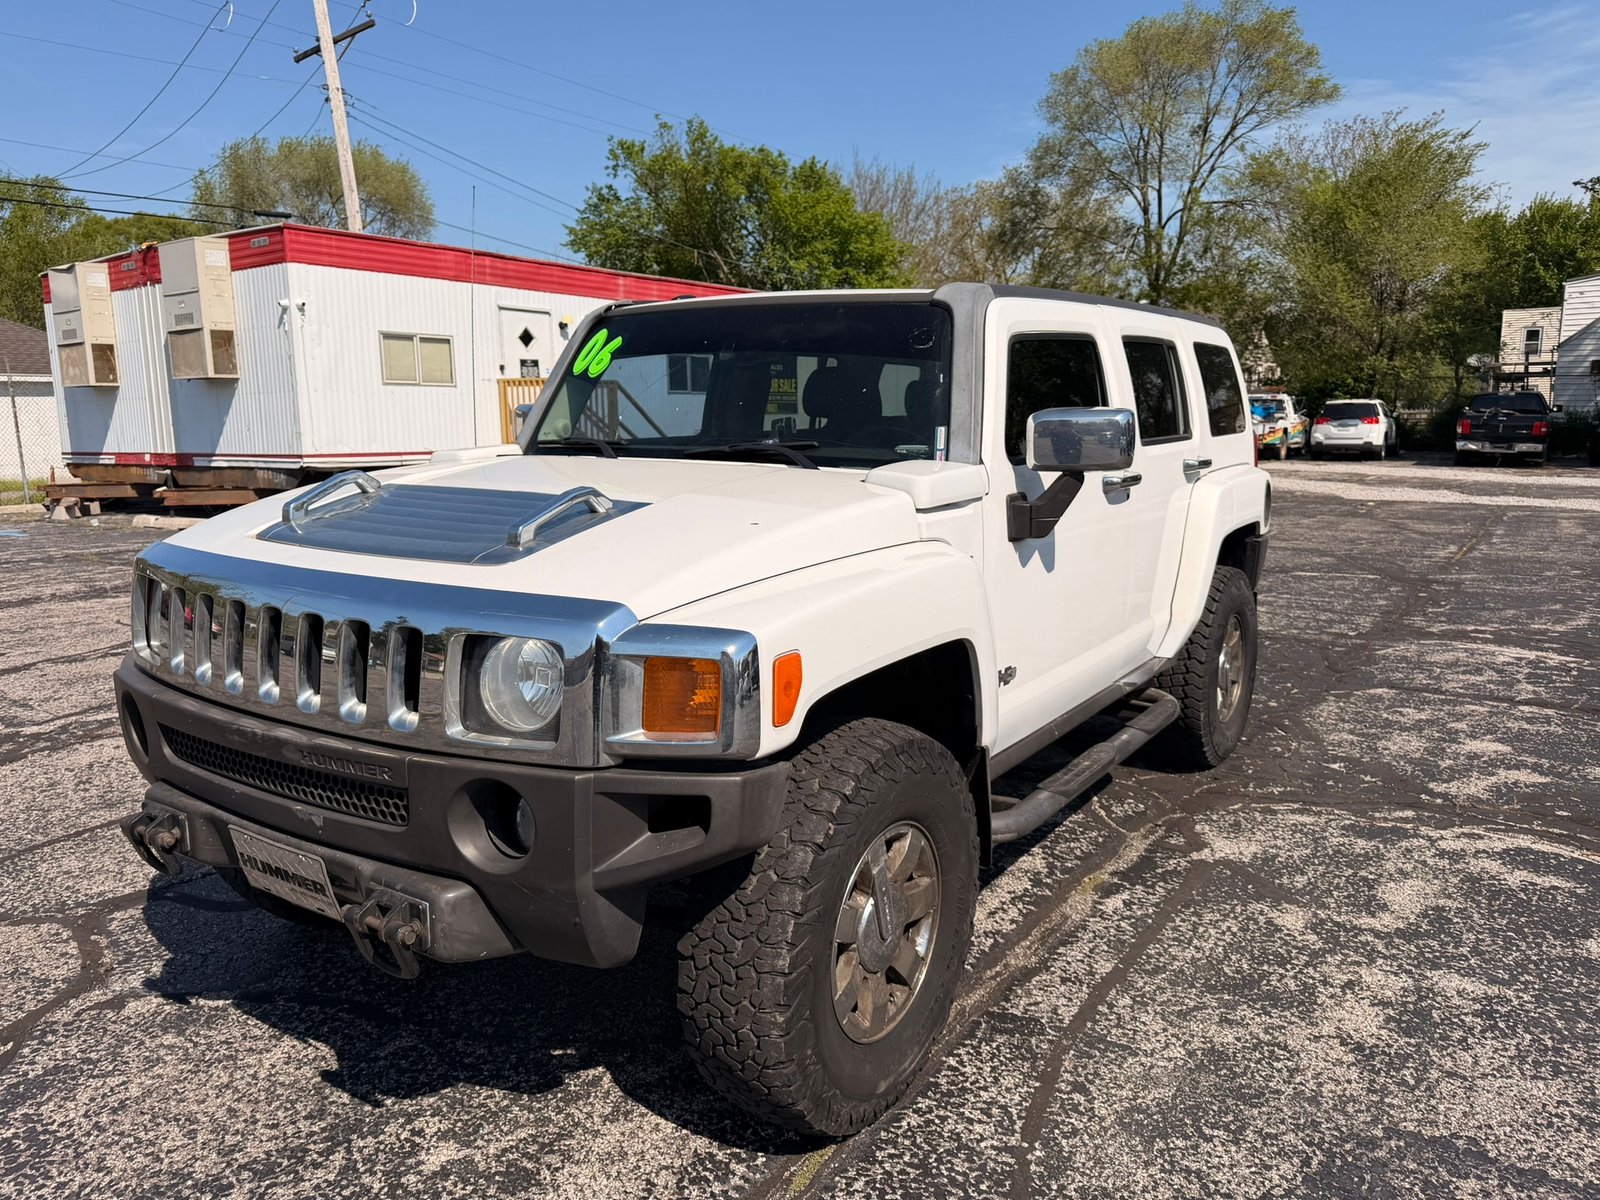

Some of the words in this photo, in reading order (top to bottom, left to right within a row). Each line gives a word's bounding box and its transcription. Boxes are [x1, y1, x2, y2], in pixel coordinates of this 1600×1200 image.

[574, 330, 622, 377] 06
[779, 378, 796, 392] SALE
[297, 750, 393, 781] HUMMER
[238, 853, 329, 898] HUMMER
